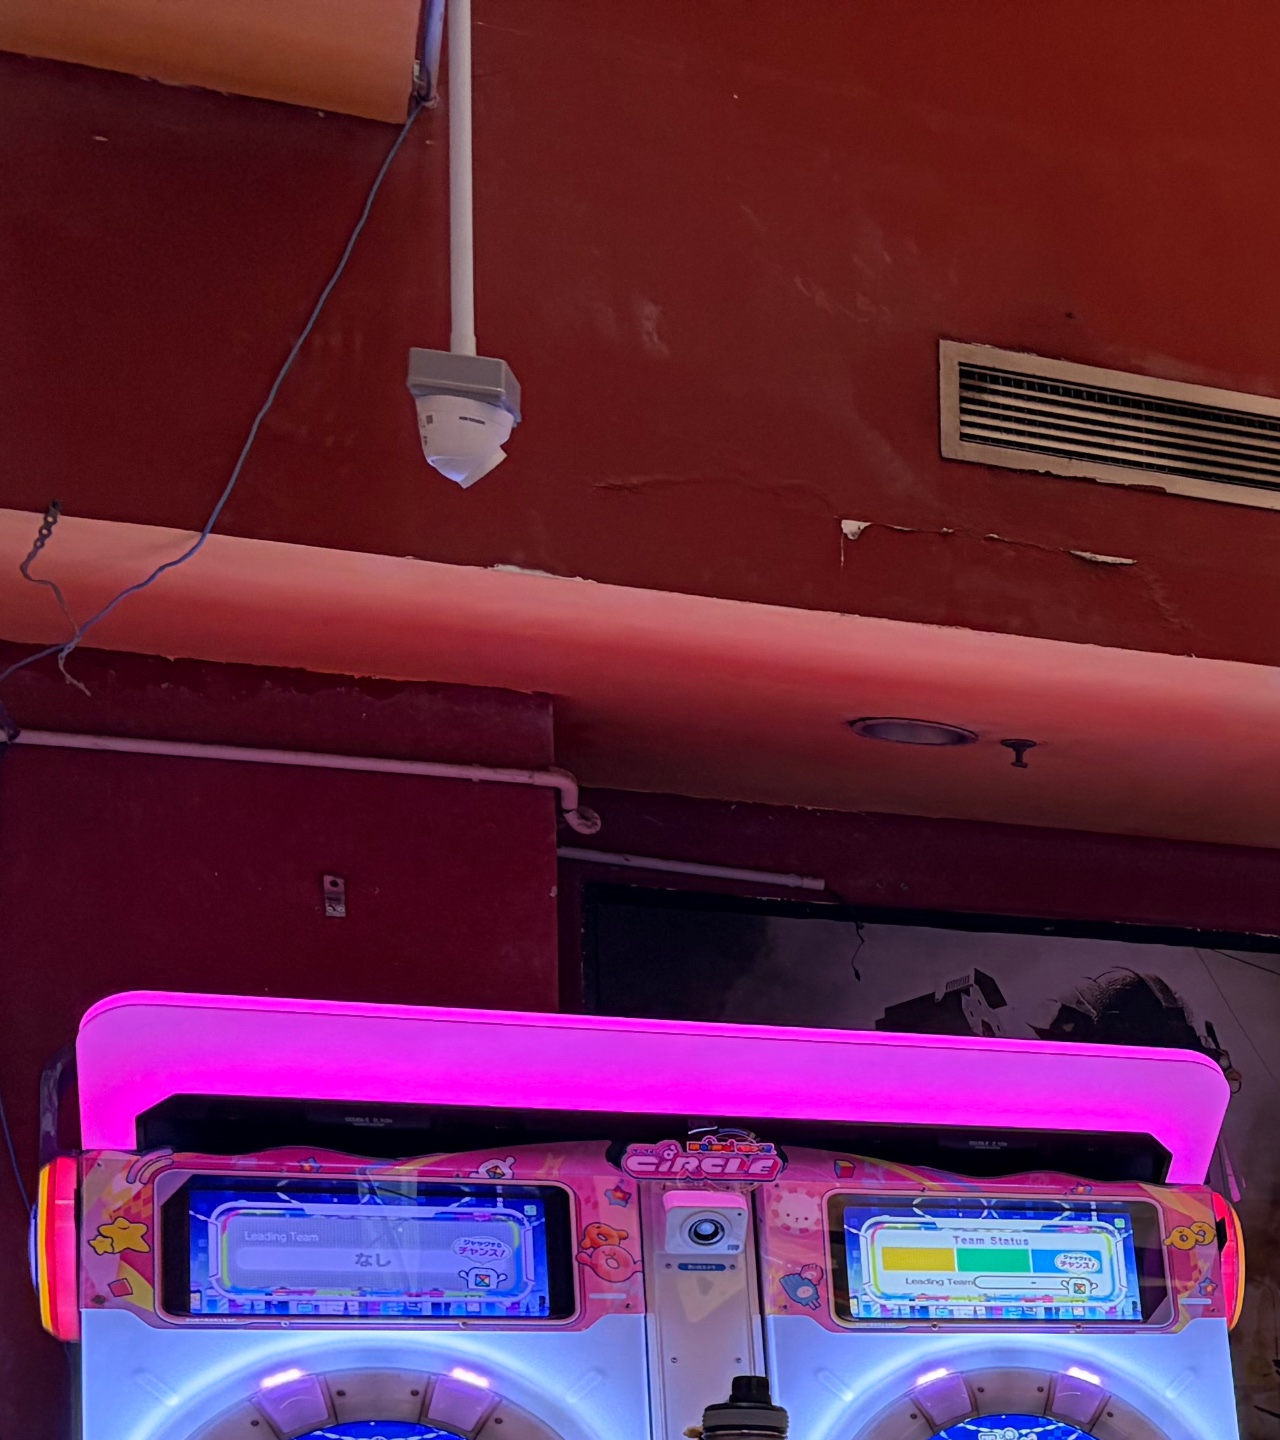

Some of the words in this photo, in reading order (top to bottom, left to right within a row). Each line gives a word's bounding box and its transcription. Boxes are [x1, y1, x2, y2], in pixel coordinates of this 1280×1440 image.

[244, 1231, 287, 1243] Leading
[289, 1231, 319, 1242] Team
[953, 1235, 985, 1246] Team
[990, 1236, 1029, 1246] Status
[355, 1252, 392, 1268] なし
[905, 1277, 944, 1288] Leading
[947, 1278, 976, 1287] Team
